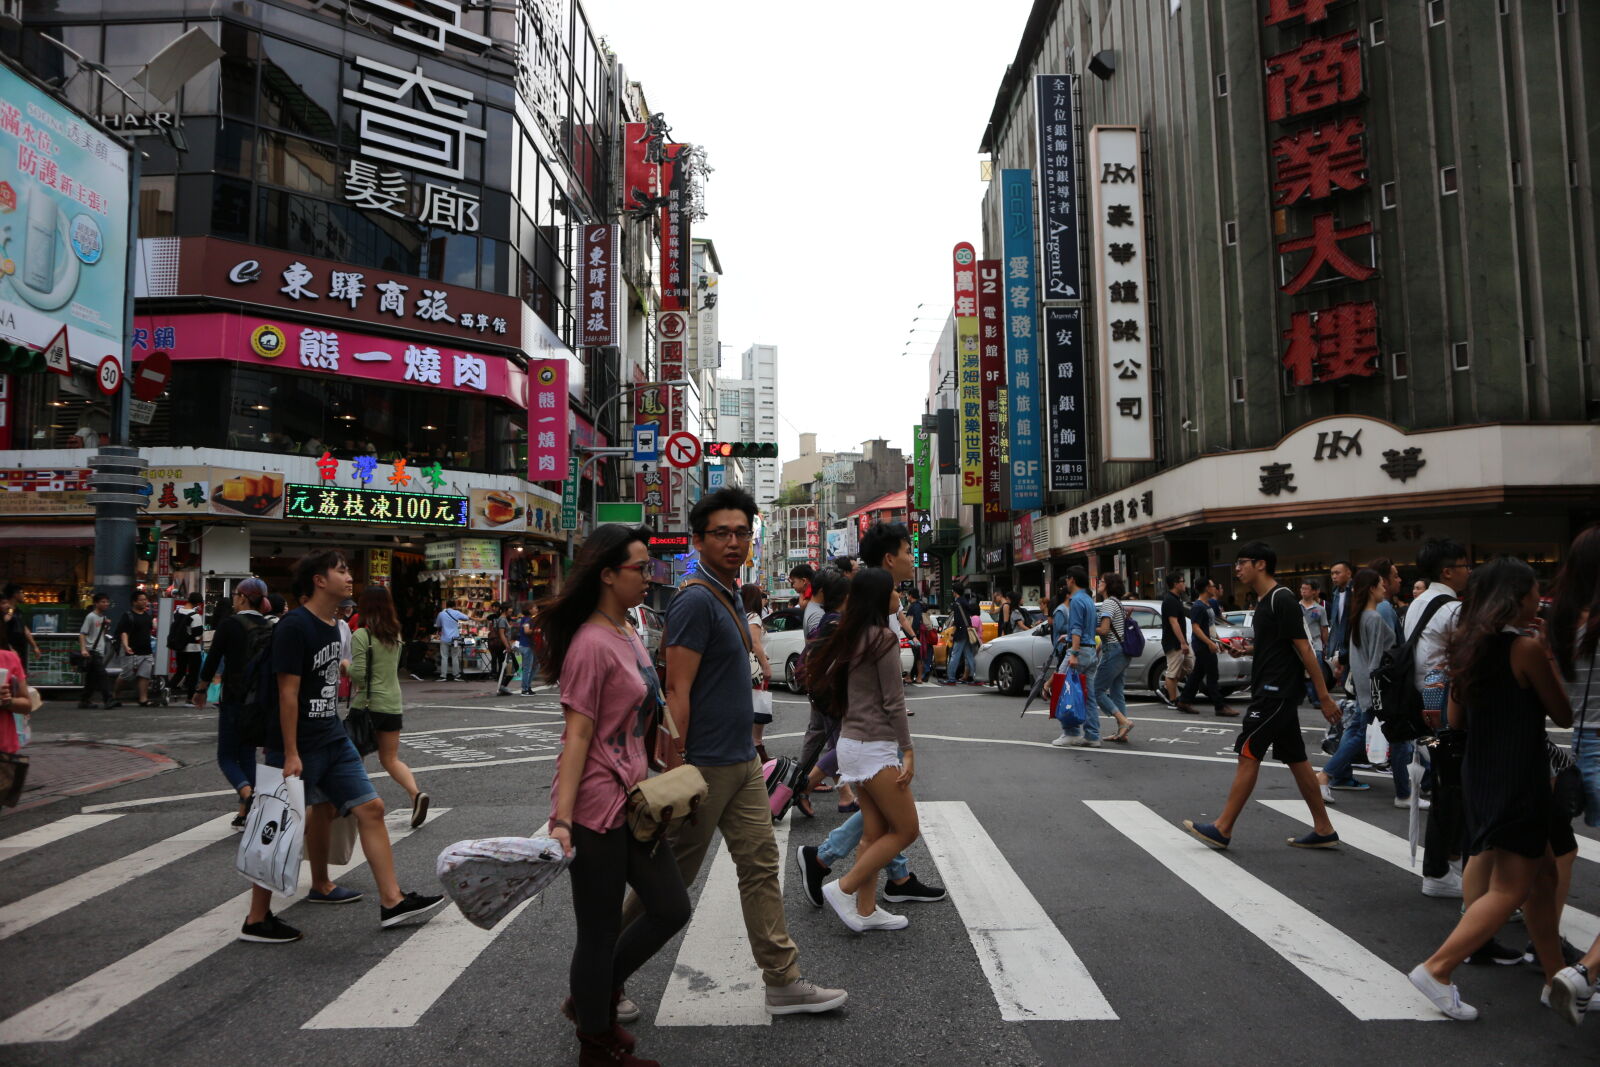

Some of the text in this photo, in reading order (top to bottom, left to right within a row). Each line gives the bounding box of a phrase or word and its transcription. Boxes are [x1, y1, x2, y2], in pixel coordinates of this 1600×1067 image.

[343, 159, 481, 233] 髮廊
[955, 270, 975, 317] 萬年
[102, 366, 117, 385] 30
[299, 328, 487, 391] 熊一燒肉
[1056, 329, 1077, 446] 安爵銀飾
[538, 391, 556, 472] 熊一燒肉
[316, 452, 447, 490] 台灣美味
[963, 471, 983, 488] 5F
[1013, 461, 1039, 477] 6F
